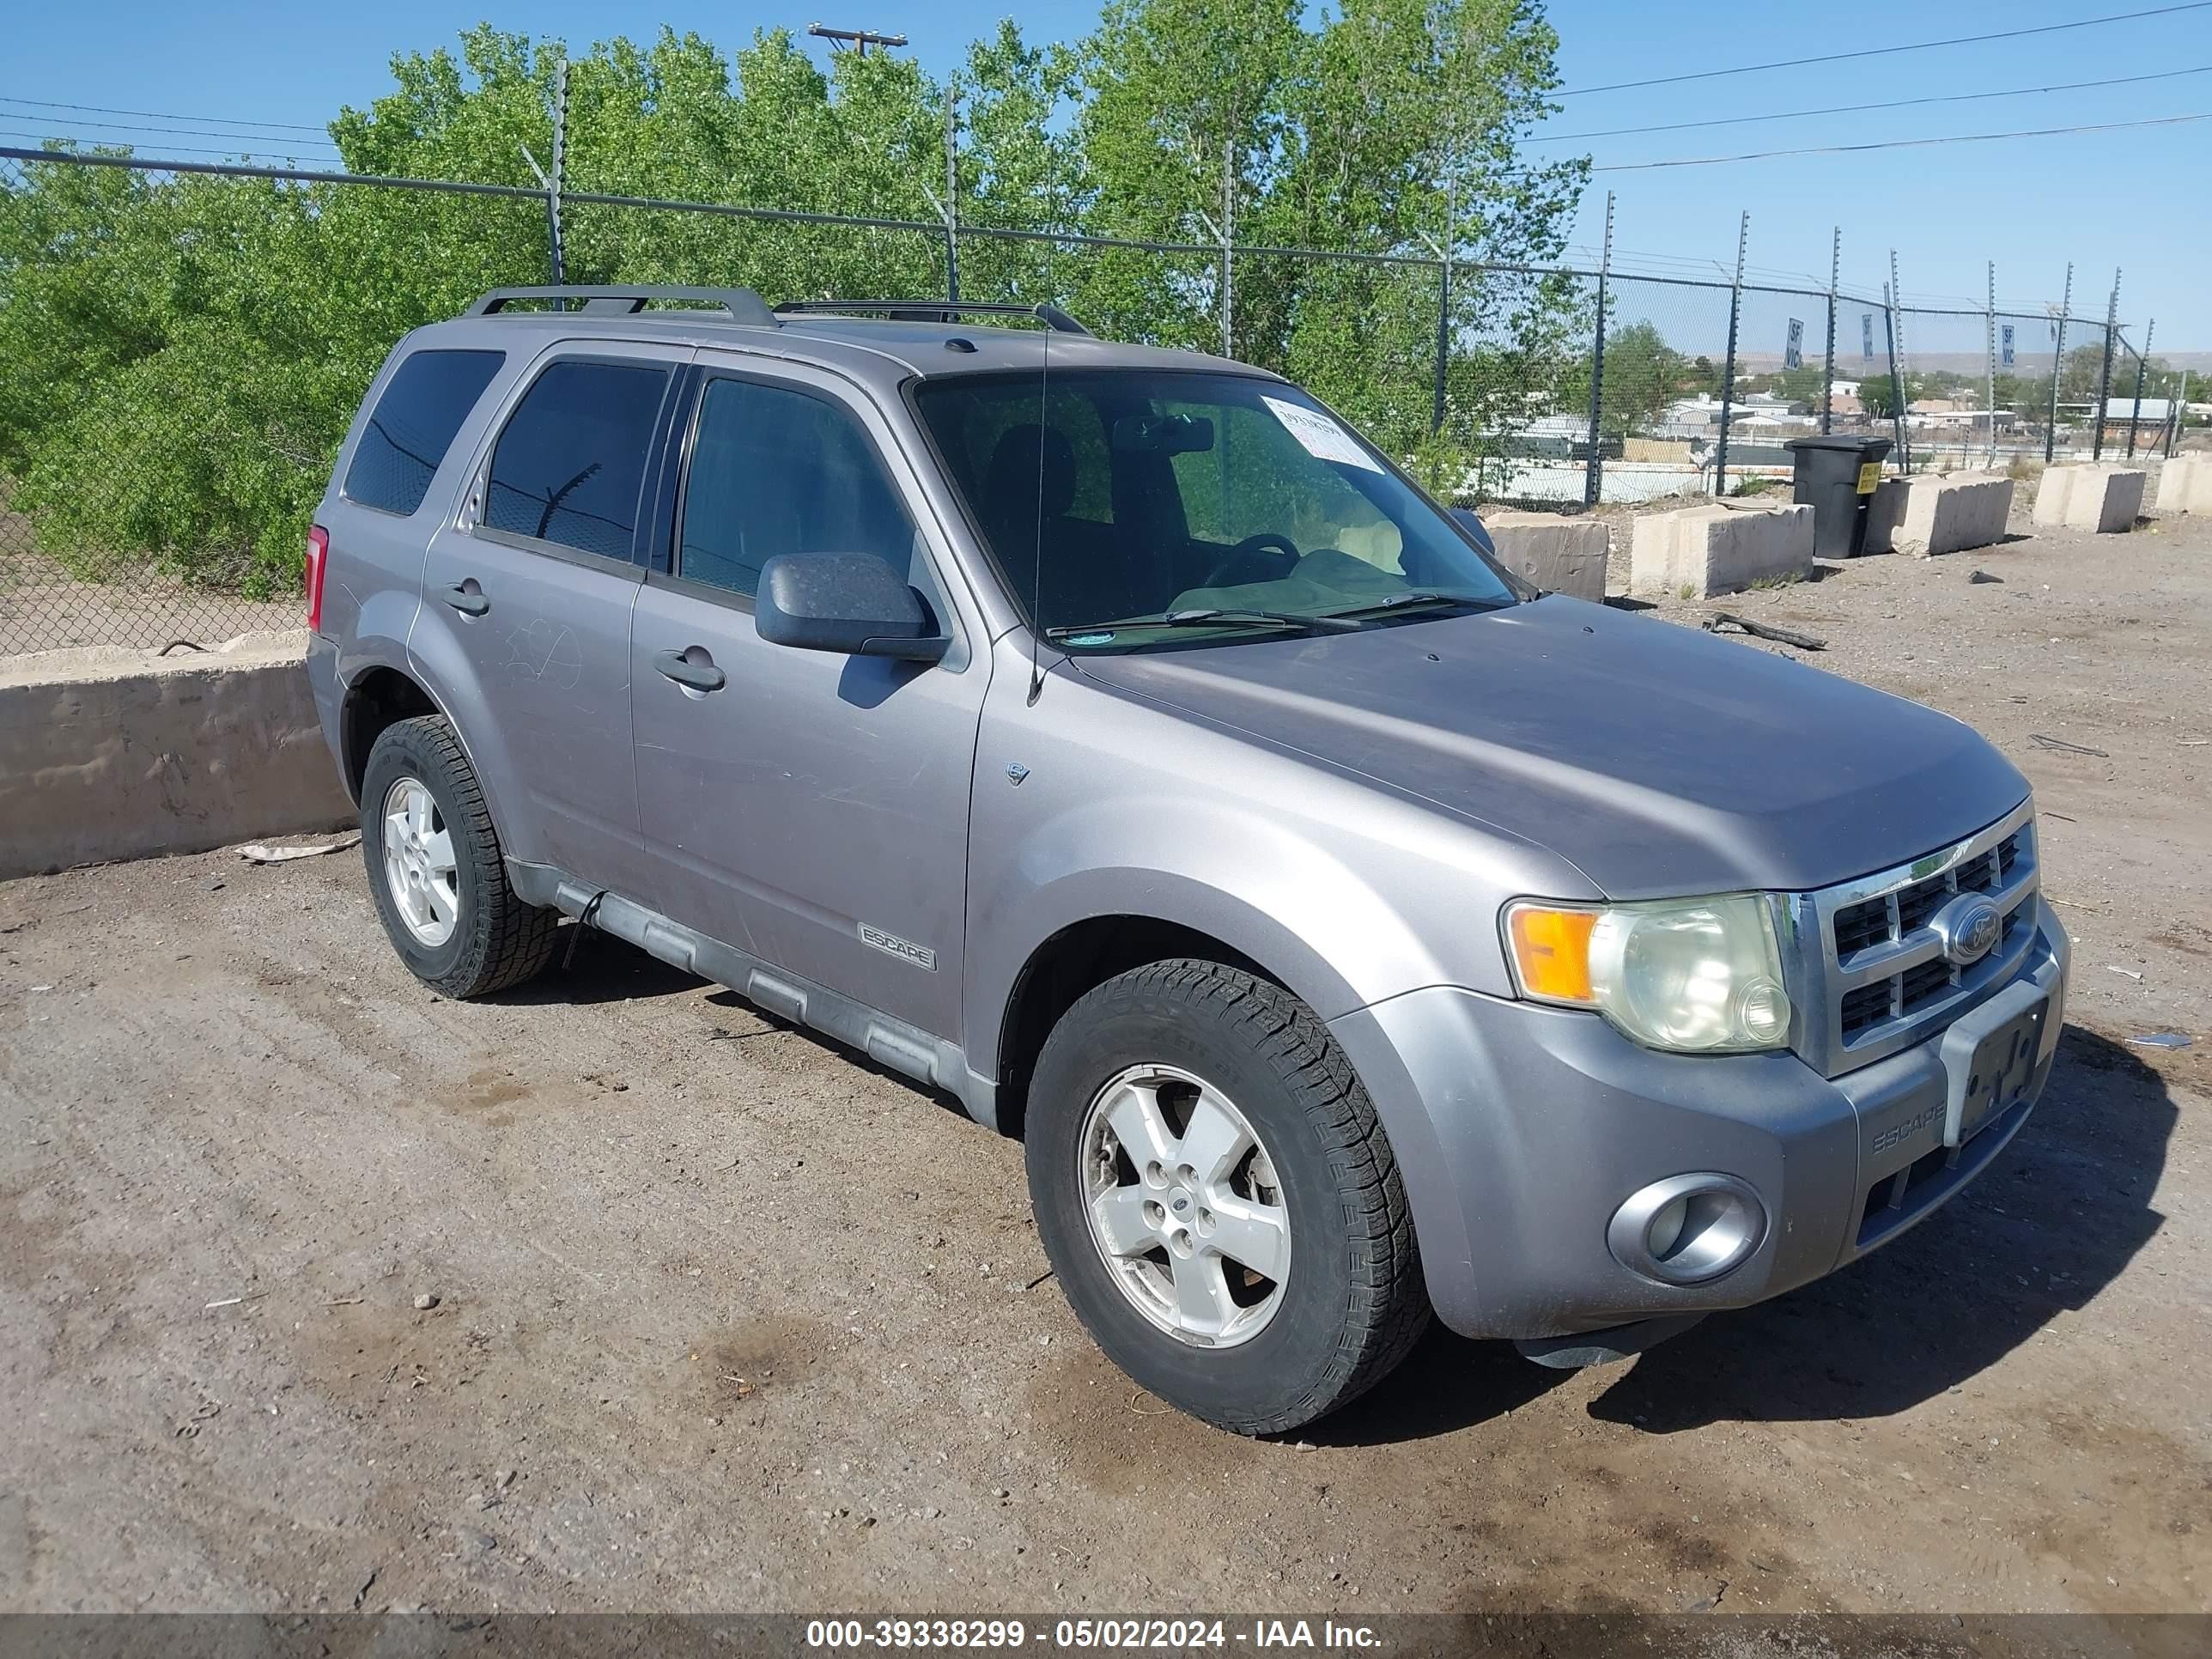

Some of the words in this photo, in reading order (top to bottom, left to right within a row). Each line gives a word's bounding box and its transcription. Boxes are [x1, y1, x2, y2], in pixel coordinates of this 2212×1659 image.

[1790, 323, 1801, 343] SF
[2004, 329, 2013, 343] SF
[1787, 347, 1800, 368] VIC
[2003, 349, 2014, 364] VIC
[1973, 915, 1999, 947] Ford
[863, 928, 930, 965] ESCAPE
[1873, 1103, 1945, 1155] ESCAPE
